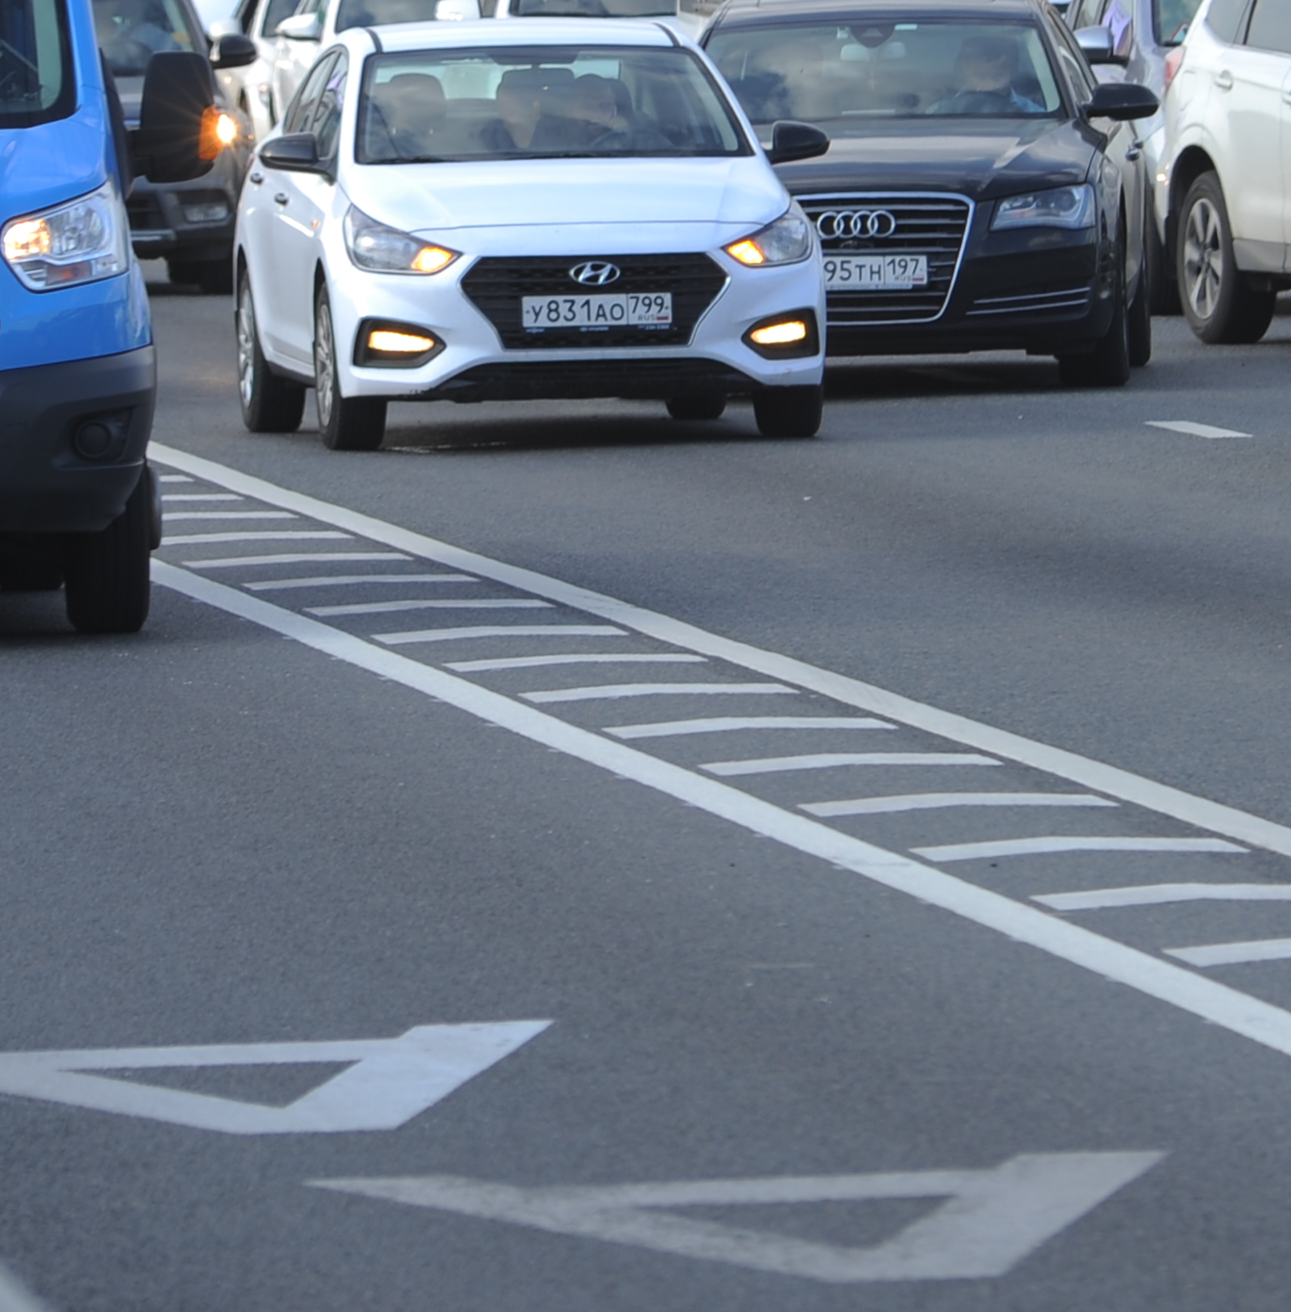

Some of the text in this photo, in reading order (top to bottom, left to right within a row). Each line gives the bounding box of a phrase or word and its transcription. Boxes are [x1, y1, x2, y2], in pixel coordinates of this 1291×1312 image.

[887, 257, 920, 276] 197
[531, 295, 665, 324] У831АО 799
[638, 314, 656, 322] RUS
